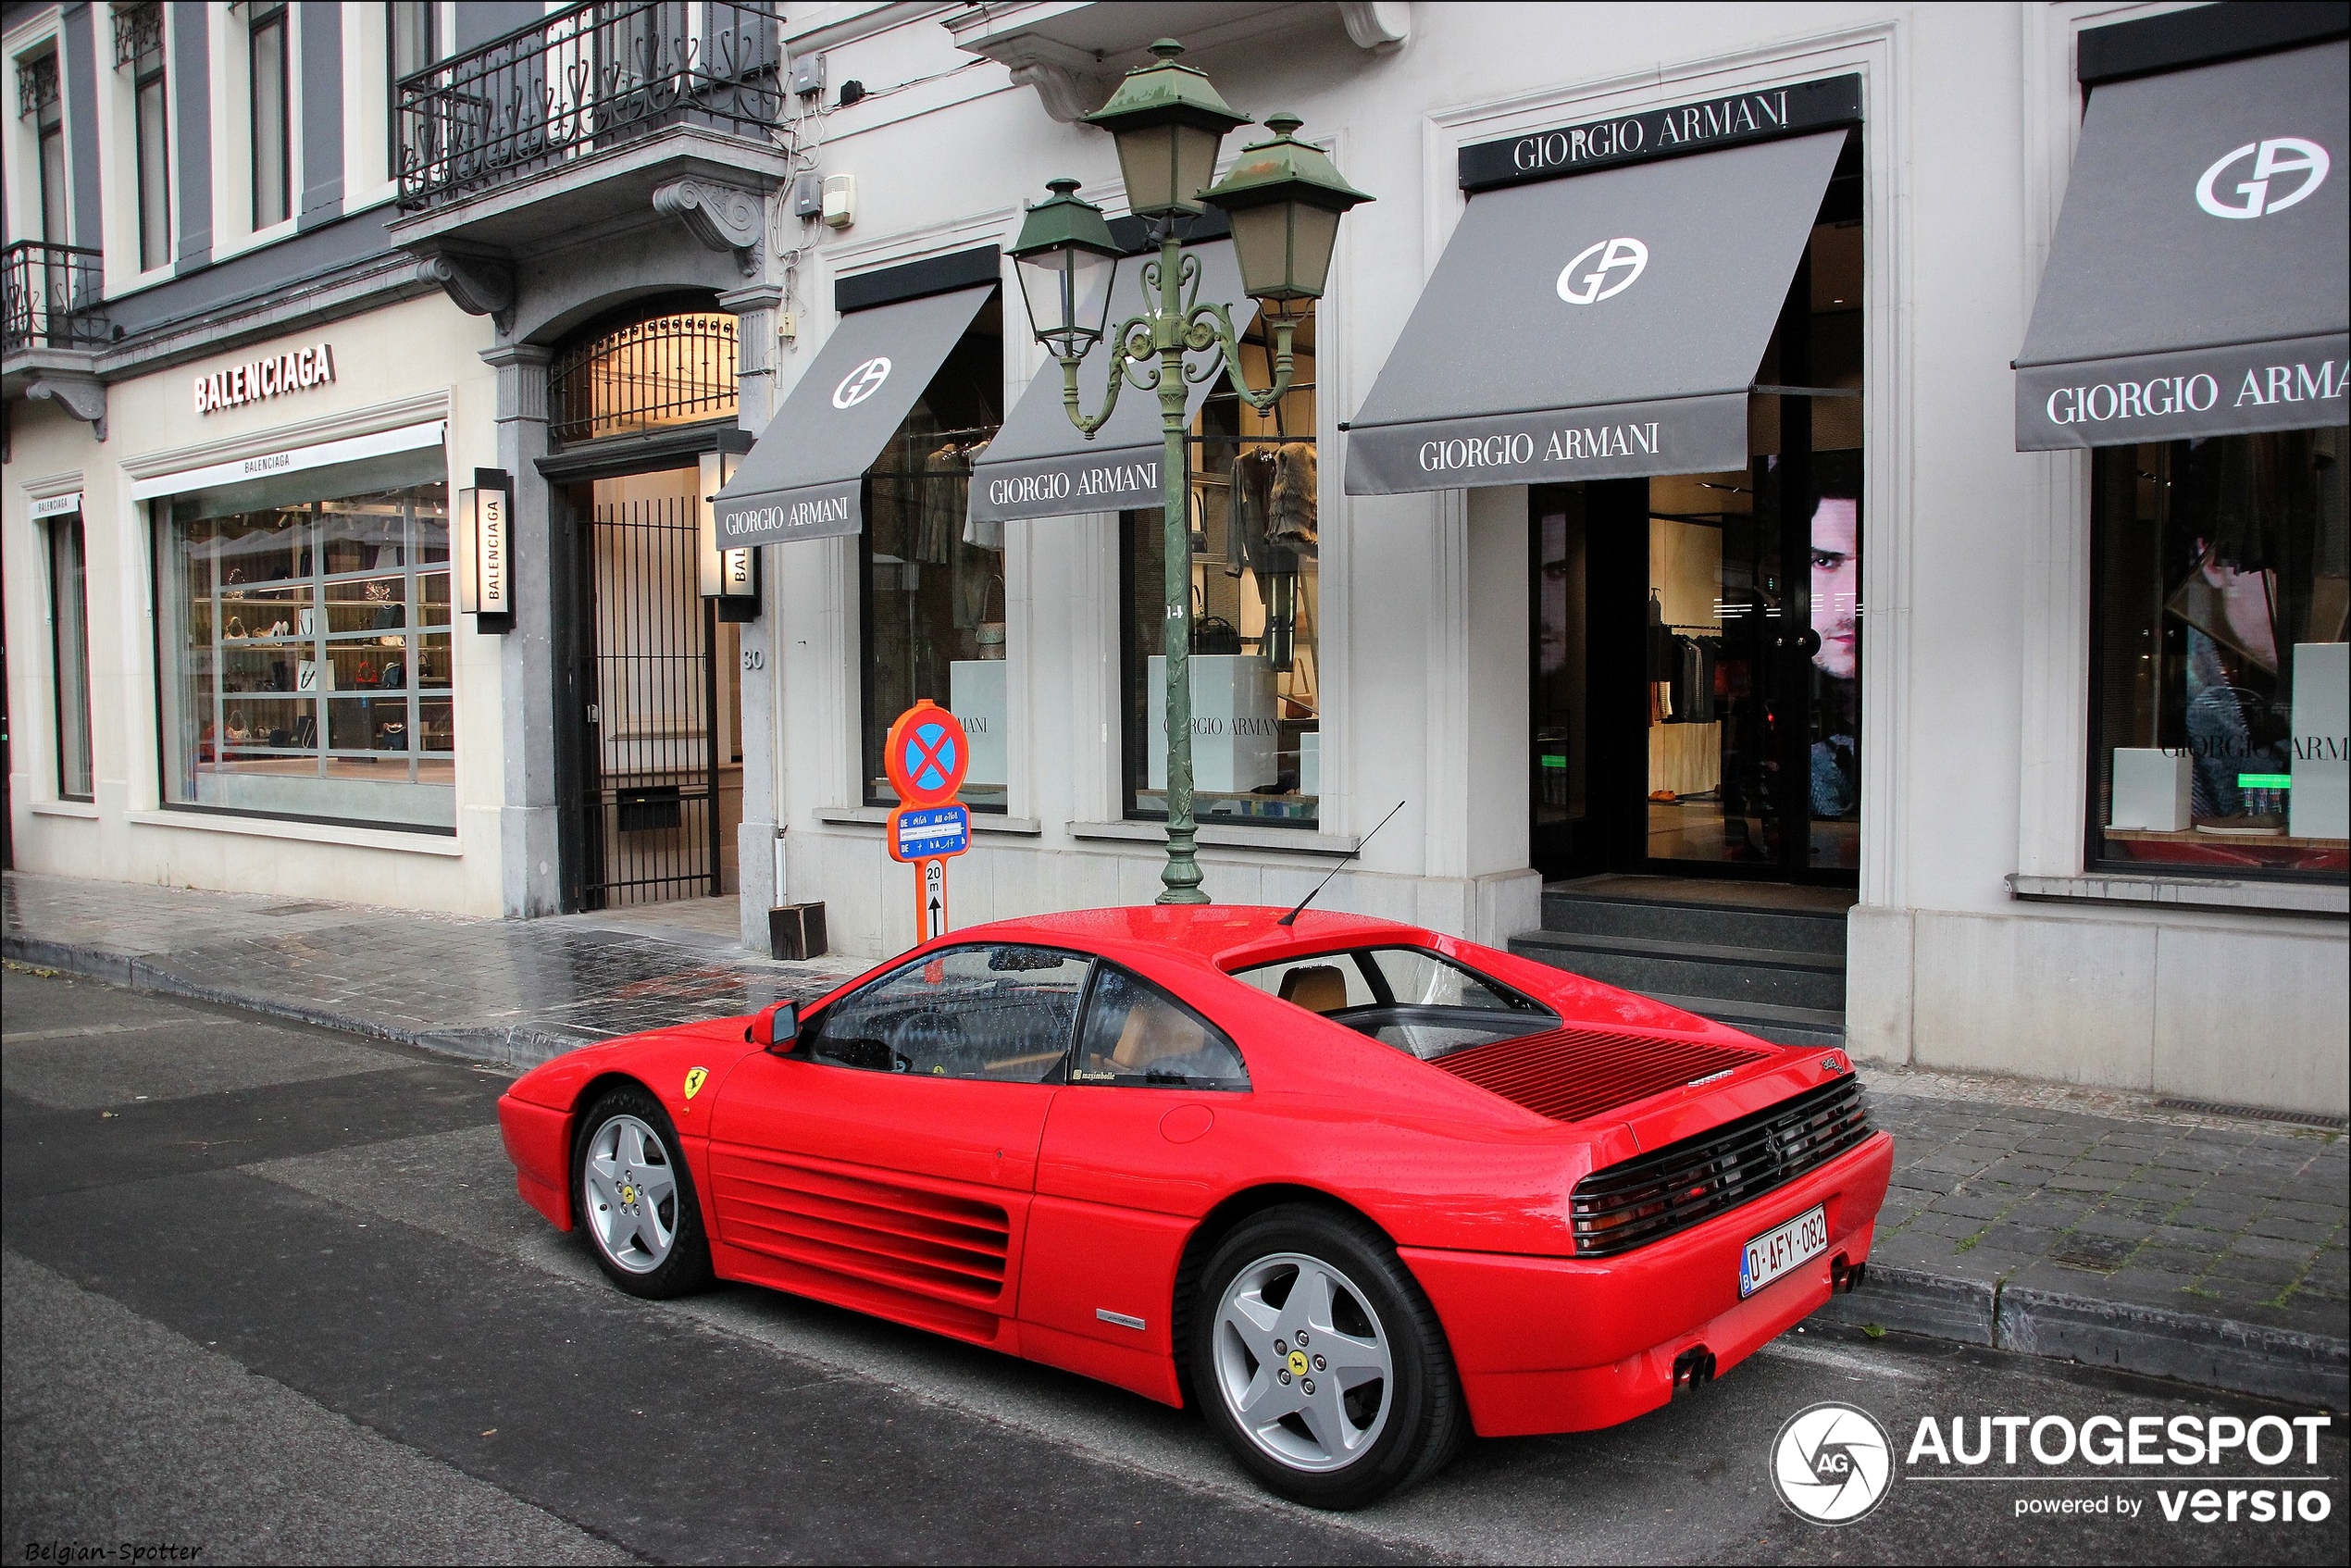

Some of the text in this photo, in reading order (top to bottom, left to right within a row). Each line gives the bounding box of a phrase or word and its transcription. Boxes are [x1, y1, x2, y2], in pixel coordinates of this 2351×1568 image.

[1513, 90, 1789, 171] GIORGIO ARMANI
[194, 343, 333, 414] BALENCIAGA
[2046, 373, 2219, 427] GIORGIO
[1419, 422, 1661, 472] GIORGIO ARMANI
[244, 454, 291, 474] BALENCIAGA
[989, 463, 1157, 505] GIORGIO ARMANI
[38, 498, 68, 513] BALENCIAGA
[726, 496, 849, 536] GIORGIO ARMANI
[488, 501, 500, 600] BALENCIAGA
[743, 648, 765, 670] 30
[1227, 716, 1286, 737] ARMANI
[935, 815, 942, 823] AU
[902, 844, 909, 852] DE
[927, 866, 940, 879] 20
[930, 882, 939, 891] m
[1742, 1274, 1750, 1289] B
